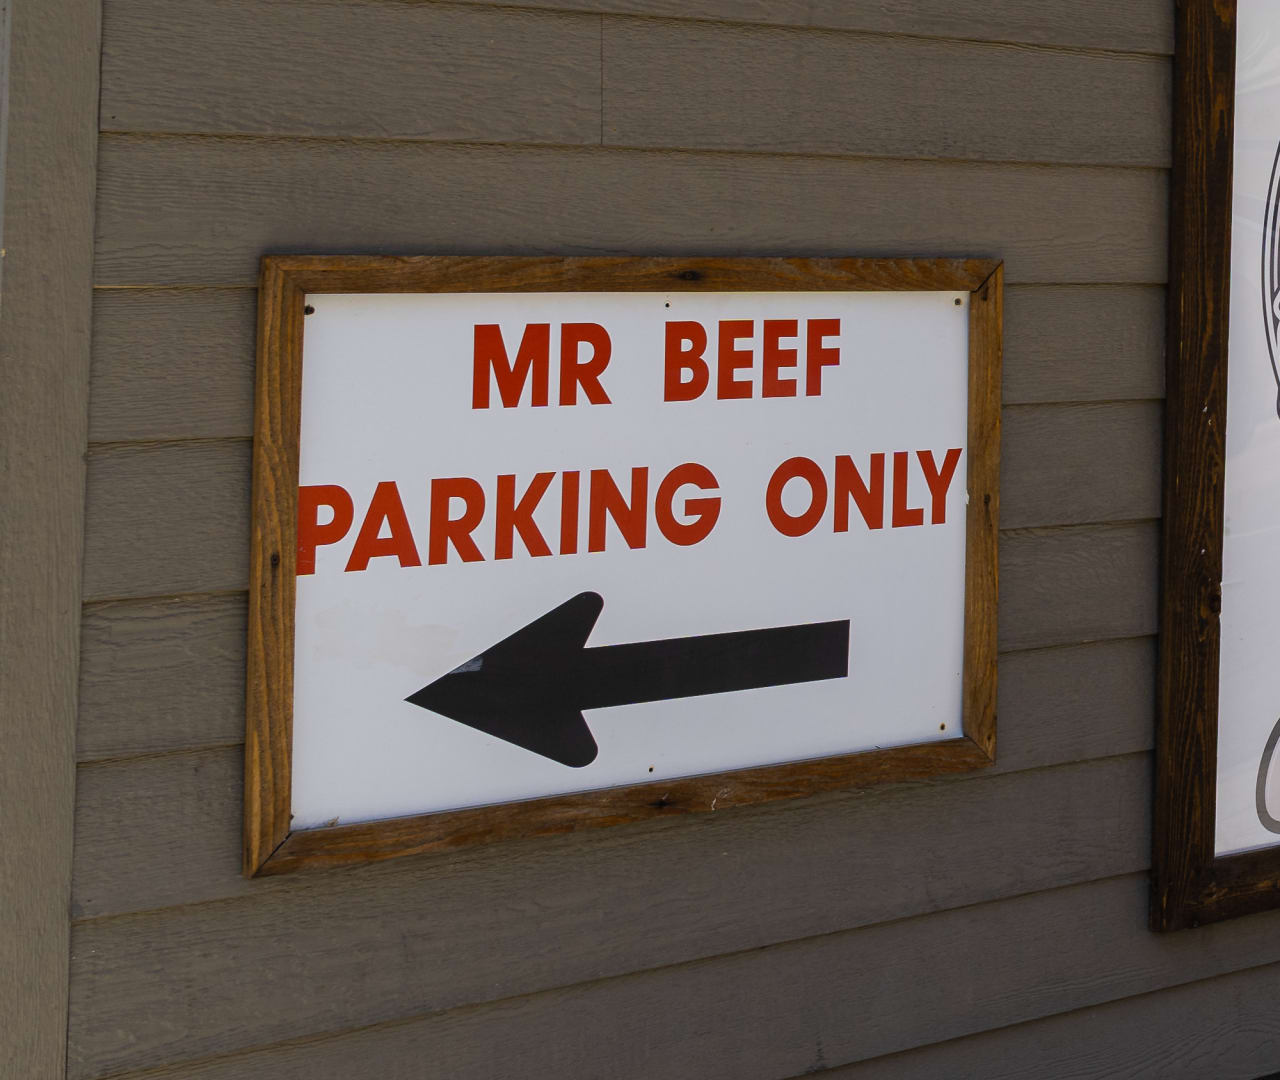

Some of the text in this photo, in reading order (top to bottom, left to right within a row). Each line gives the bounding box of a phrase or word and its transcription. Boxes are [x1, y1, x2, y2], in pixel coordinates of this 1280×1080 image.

[472, 318, 841, 410] MR BEEF
[296, 448, 962, 576] PARKING ONLY
